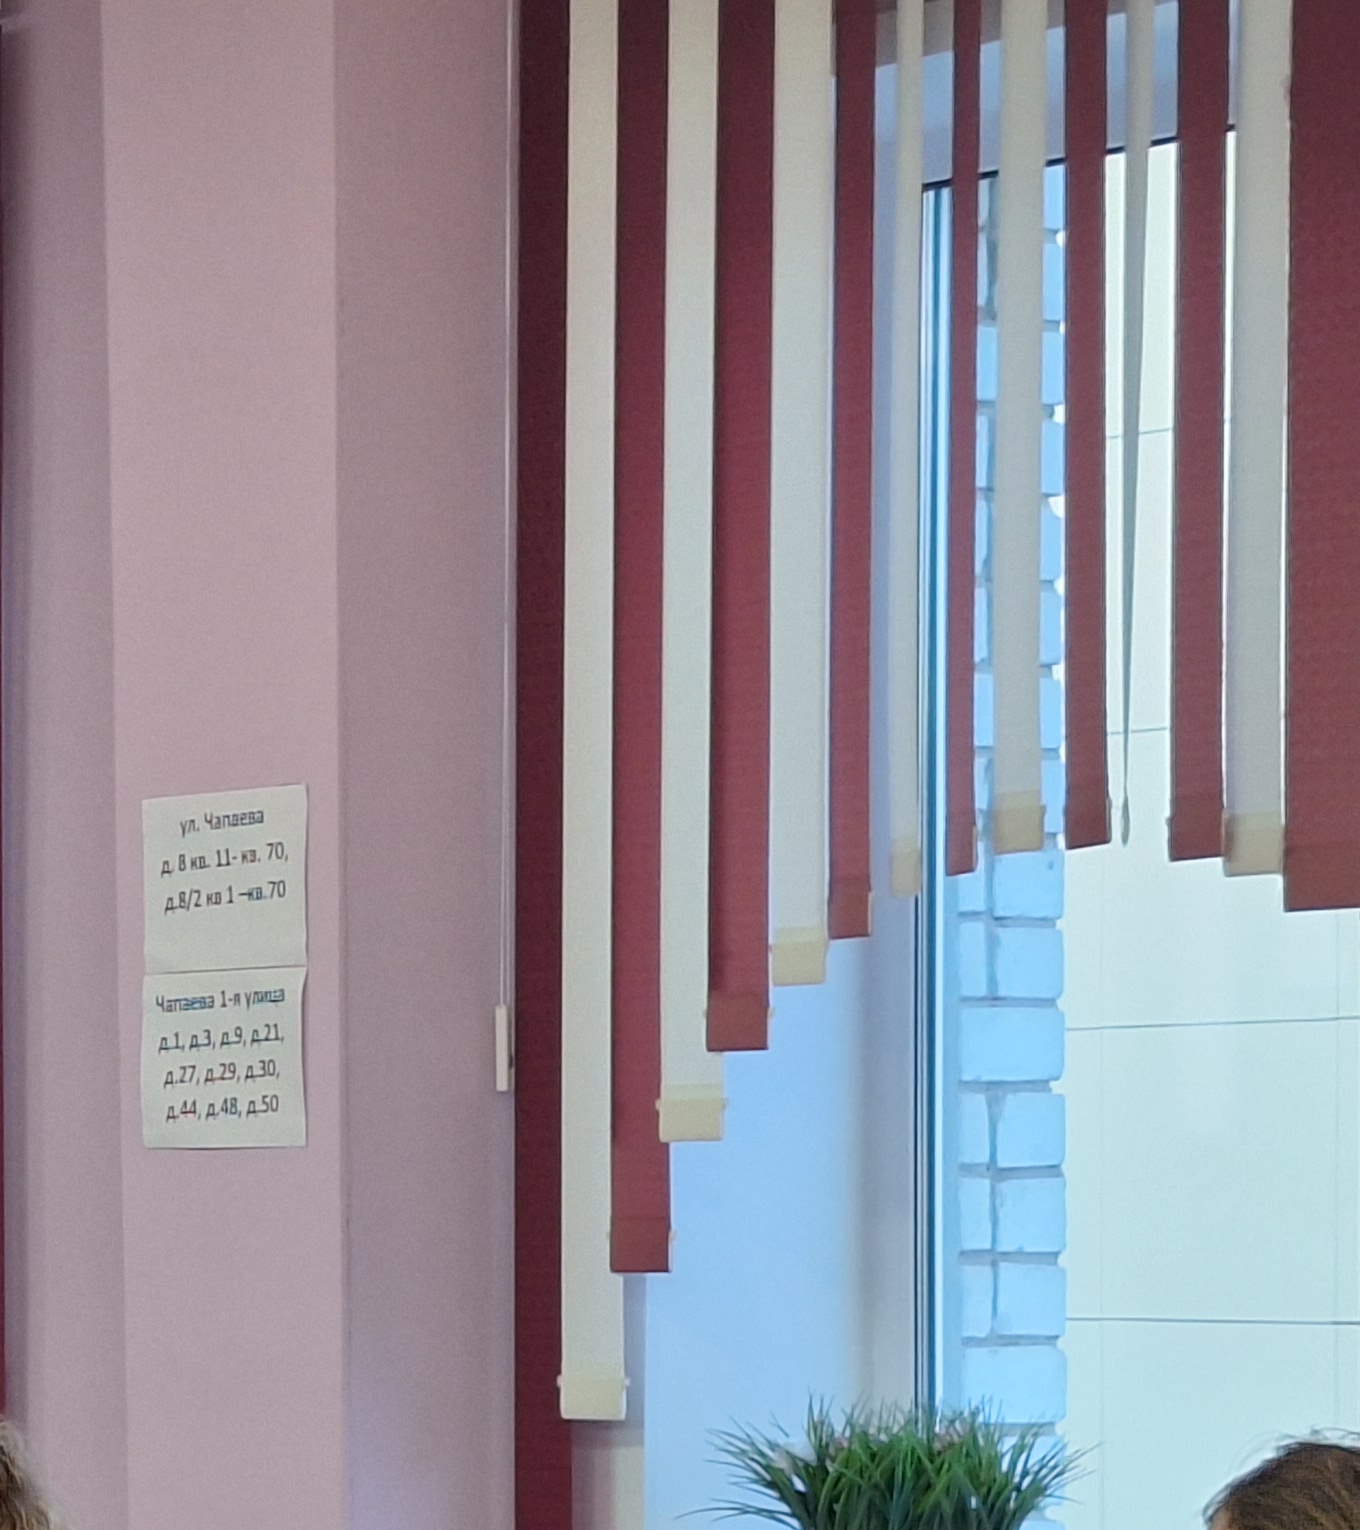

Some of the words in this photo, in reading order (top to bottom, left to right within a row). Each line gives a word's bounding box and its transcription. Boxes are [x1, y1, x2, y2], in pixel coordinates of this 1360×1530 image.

[180, 819, 200, 838] ул.
[204, 810, 264, 831] Чапаева
[241, 849, 261, 864] кв.
[156, 995, 215, 1013] Чапаева
[219, 990, 241, 1008] 1-я
[244, 988, 285, 1010] улица
[163, 1064, 201, 1089] д.27,
